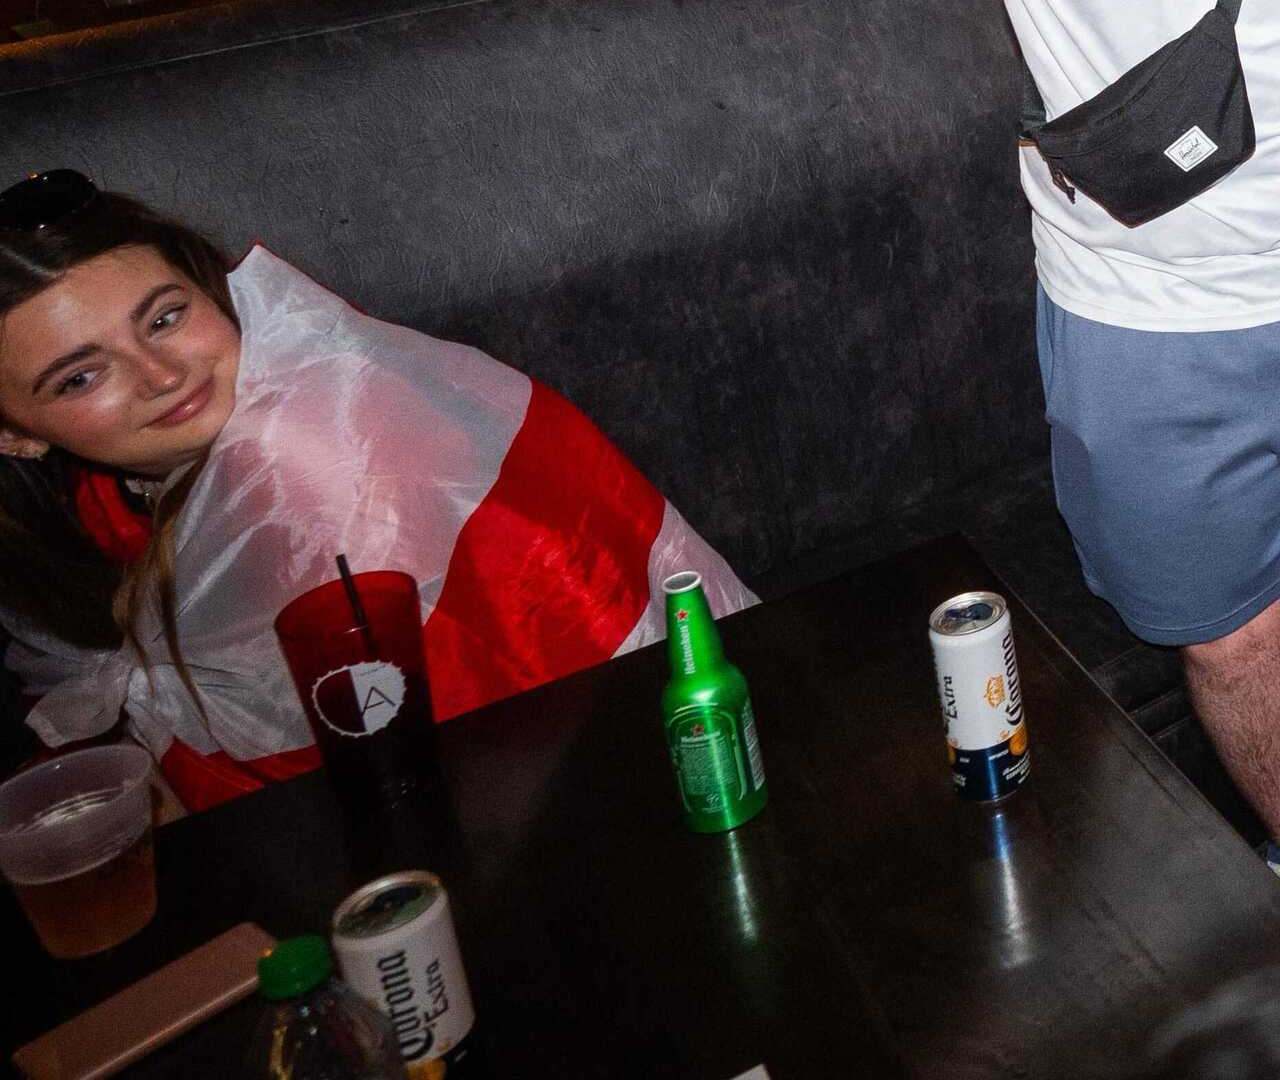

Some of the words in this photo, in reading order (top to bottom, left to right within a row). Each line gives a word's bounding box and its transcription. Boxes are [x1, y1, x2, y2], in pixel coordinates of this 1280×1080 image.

[679, 625, 696, 675] Heineken
[1002, 629, 1023, 726] Corona
[943, 676, 957, 719] Extra
[376, 948, 434, 1063] Corona
[425, 957, 450, 1025] Extra
